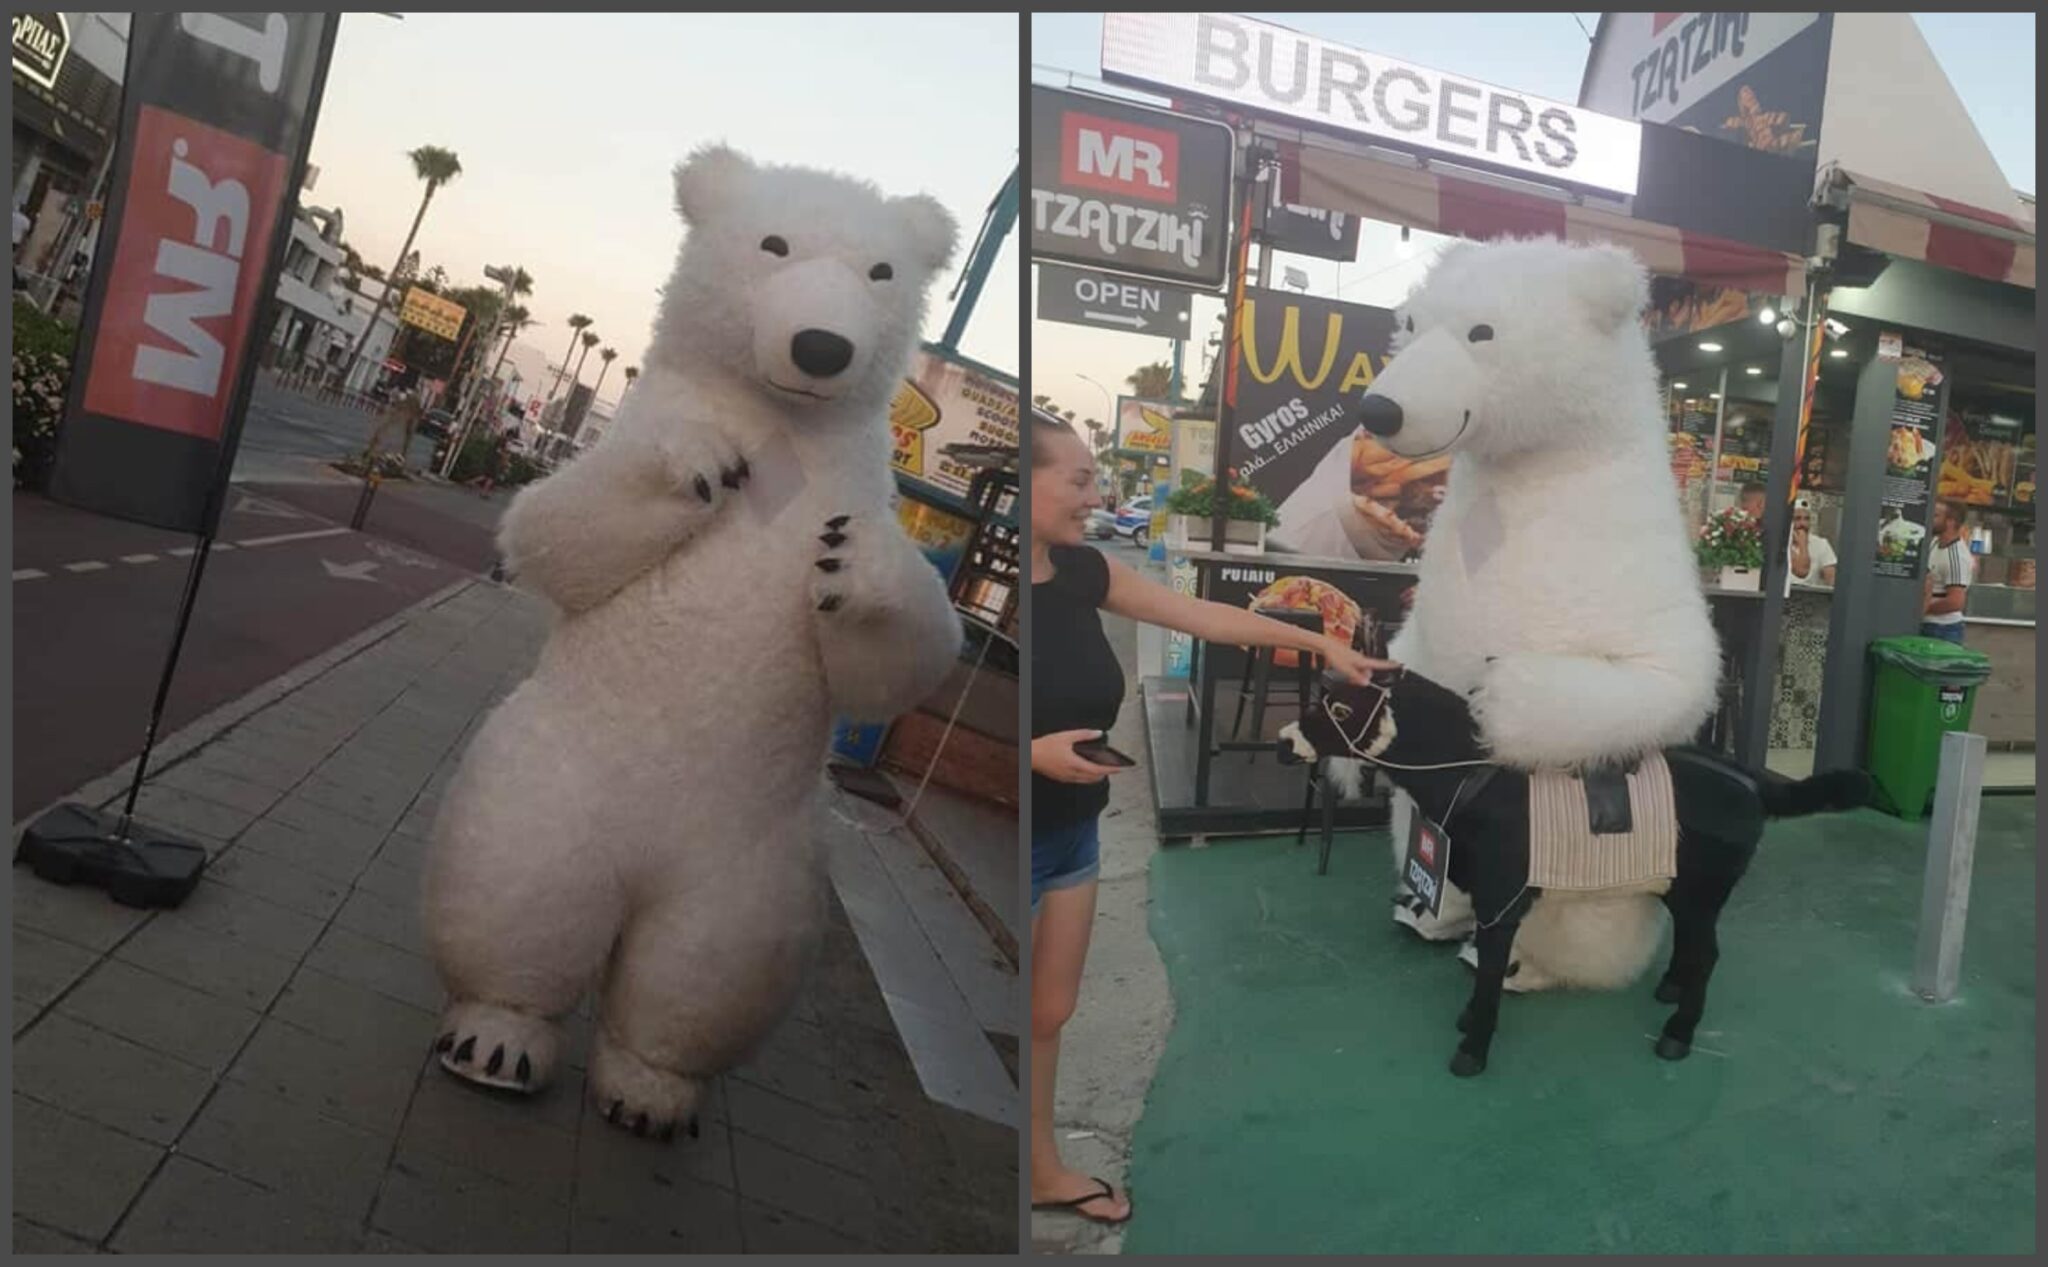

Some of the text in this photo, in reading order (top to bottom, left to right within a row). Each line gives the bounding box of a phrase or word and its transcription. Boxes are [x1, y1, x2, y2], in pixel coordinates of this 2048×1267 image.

[1193, 14, 1579, 169] BURGERS
[1032, 189, 1205, 268] TZATZIKI
[1074, 278, 1161, 313] OPEN
[1241, 299, 1390, 393] WA
[1239, 398, 1309, 450] Gyros
